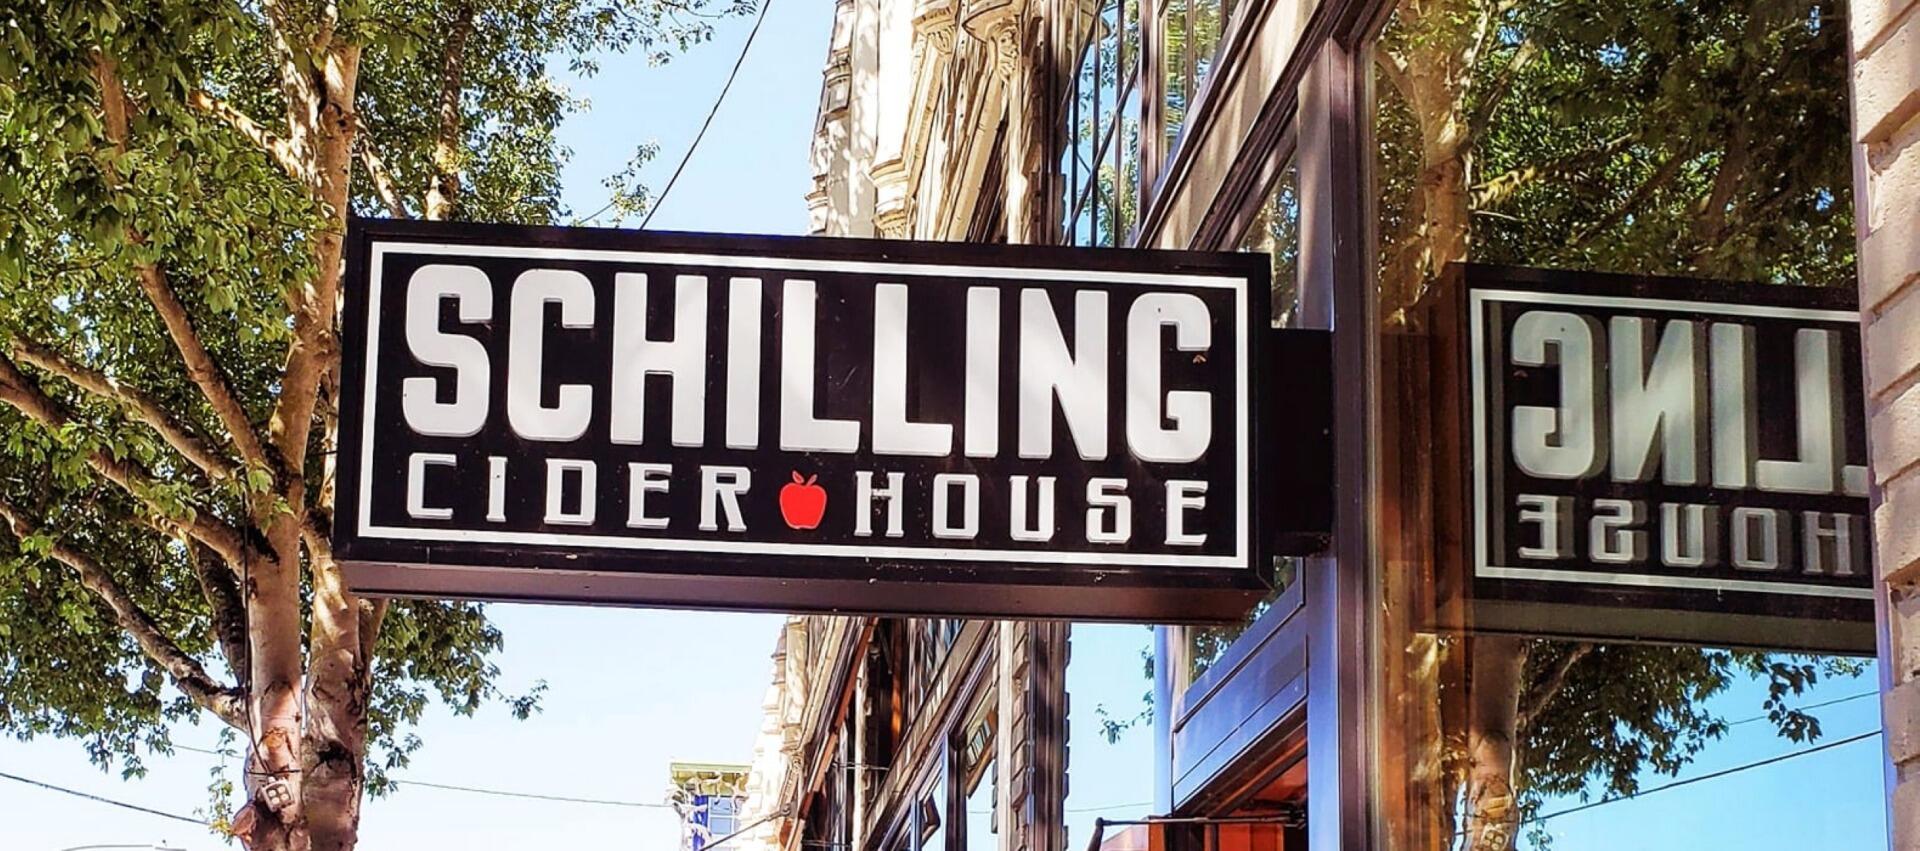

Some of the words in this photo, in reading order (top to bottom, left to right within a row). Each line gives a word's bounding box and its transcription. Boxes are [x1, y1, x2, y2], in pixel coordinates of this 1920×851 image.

[402, 263, 1212, 464] SCHILLING
[406, 452, 751, 533] CIDER
[855, 470, 1209, 547] HOUSE
